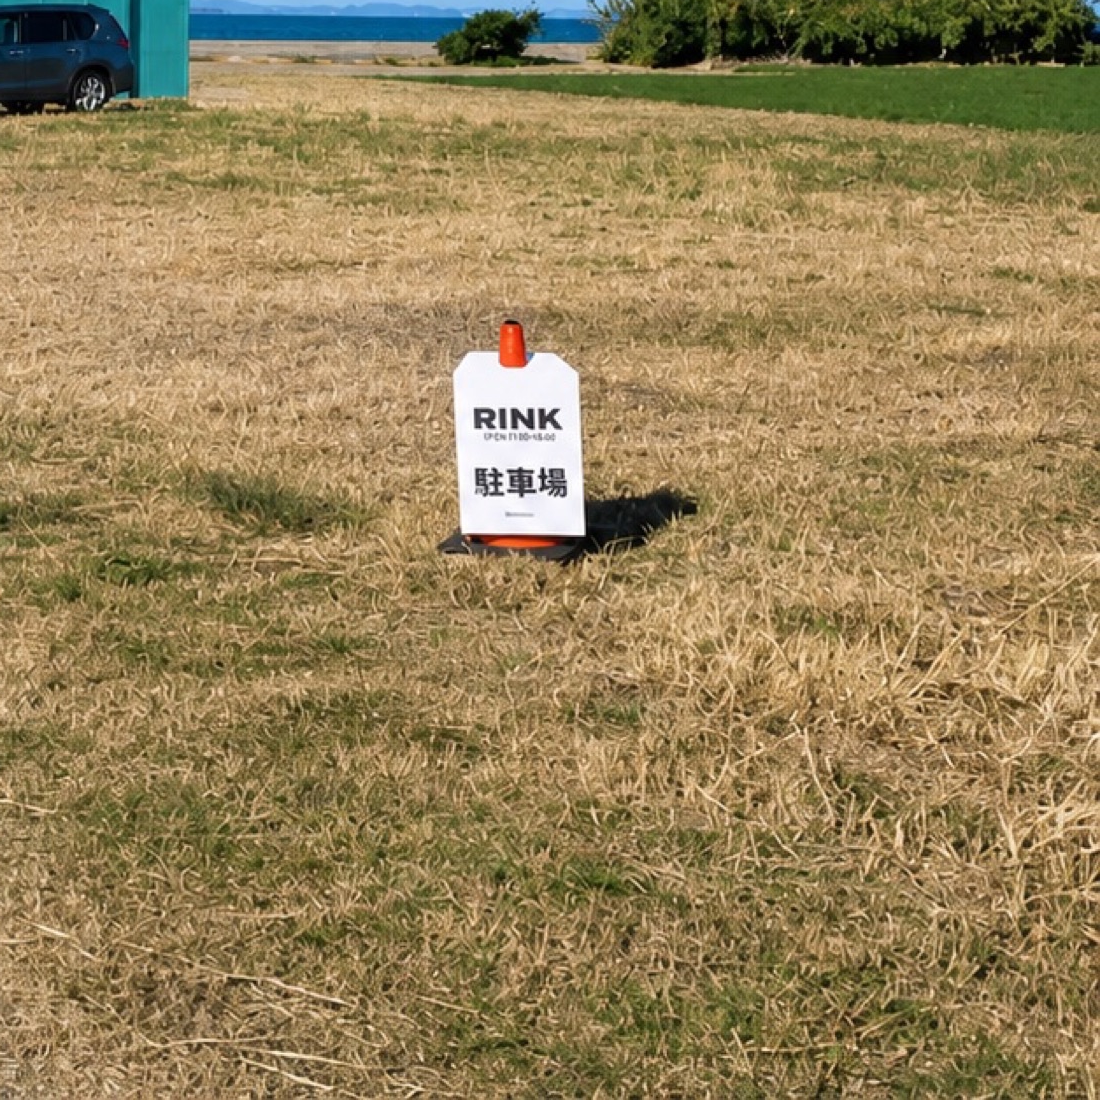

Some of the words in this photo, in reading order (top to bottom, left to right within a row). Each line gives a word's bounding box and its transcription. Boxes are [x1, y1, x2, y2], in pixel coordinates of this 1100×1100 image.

[473, 407, 563, 430] RINK
[474, 466, 568, 498] 駐車場
